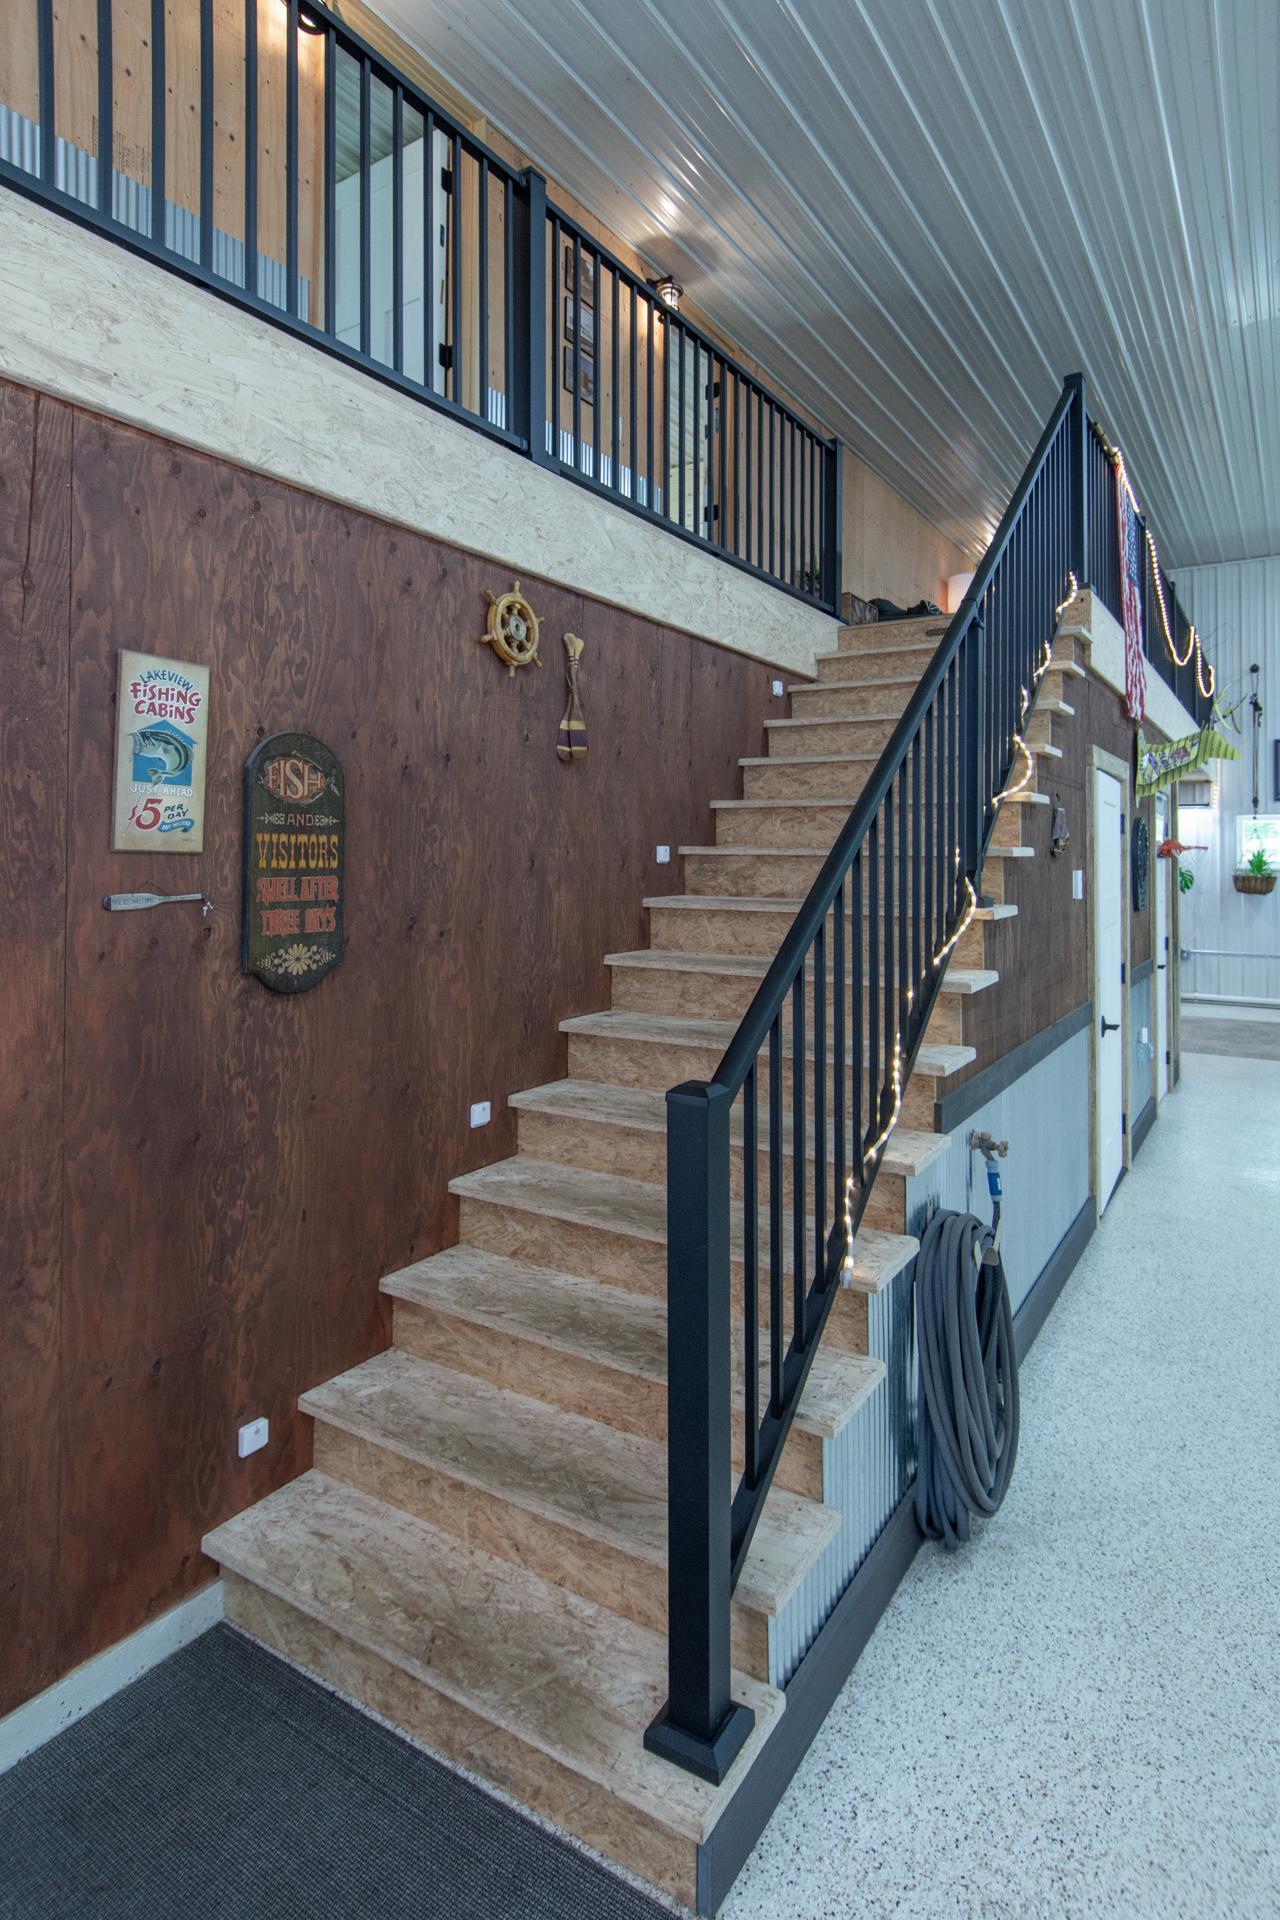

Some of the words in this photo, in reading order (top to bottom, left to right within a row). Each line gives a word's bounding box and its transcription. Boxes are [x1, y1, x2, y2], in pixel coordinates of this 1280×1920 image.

[139, 669, 194, 691] LAKEVIEW
[267, 759, 323, 799] FISH
[130, 783, 159, 794] JUST
[162, 786, 193, 797] AHEAD
[164, 803, 184, 813] PER
[167, 809, 189, 820] DAY
[287, 813, 313, 827] AND
[256, 832, 339, 870] VISITORS
[300, 875, 339, 903] AFTER
